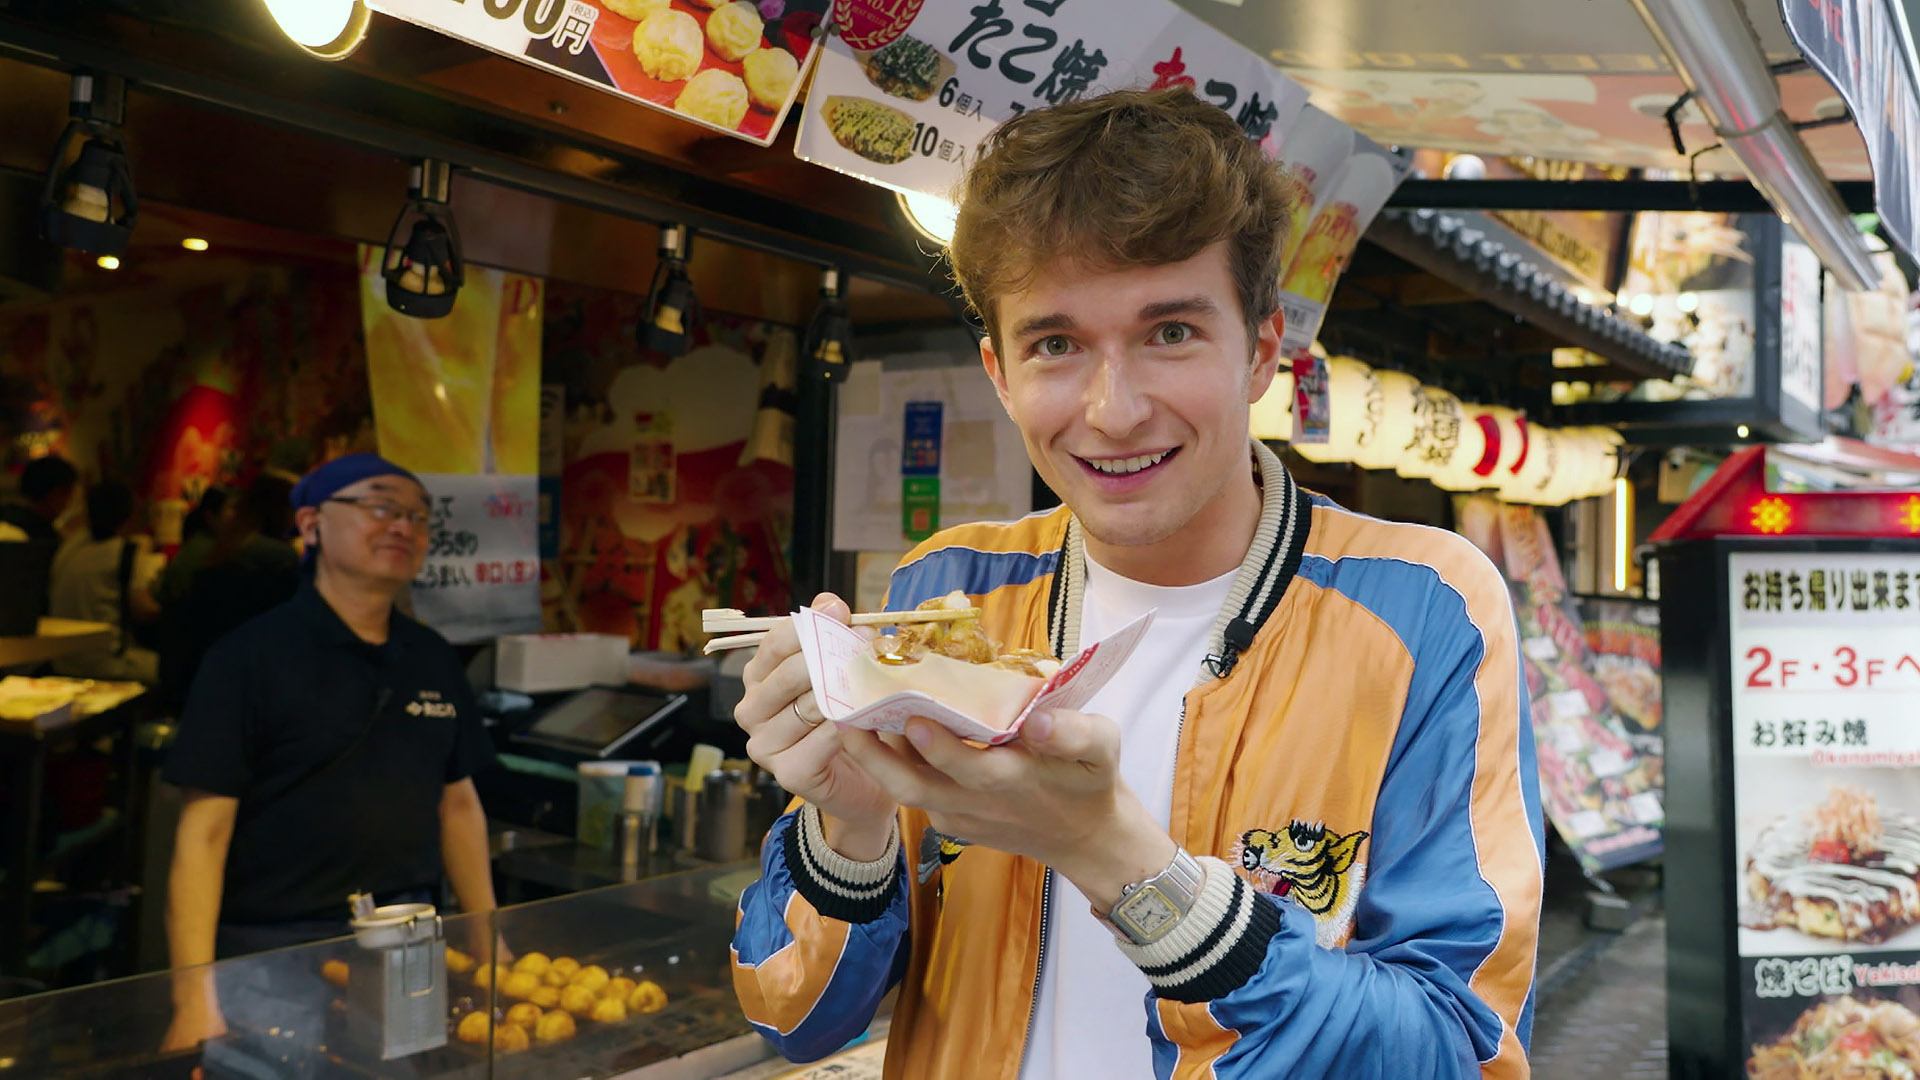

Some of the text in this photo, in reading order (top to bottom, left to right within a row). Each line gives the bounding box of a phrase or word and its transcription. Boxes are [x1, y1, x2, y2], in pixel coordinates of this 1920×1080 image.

[1744, 569, 1920, 612] お持ち帰り出来ま
